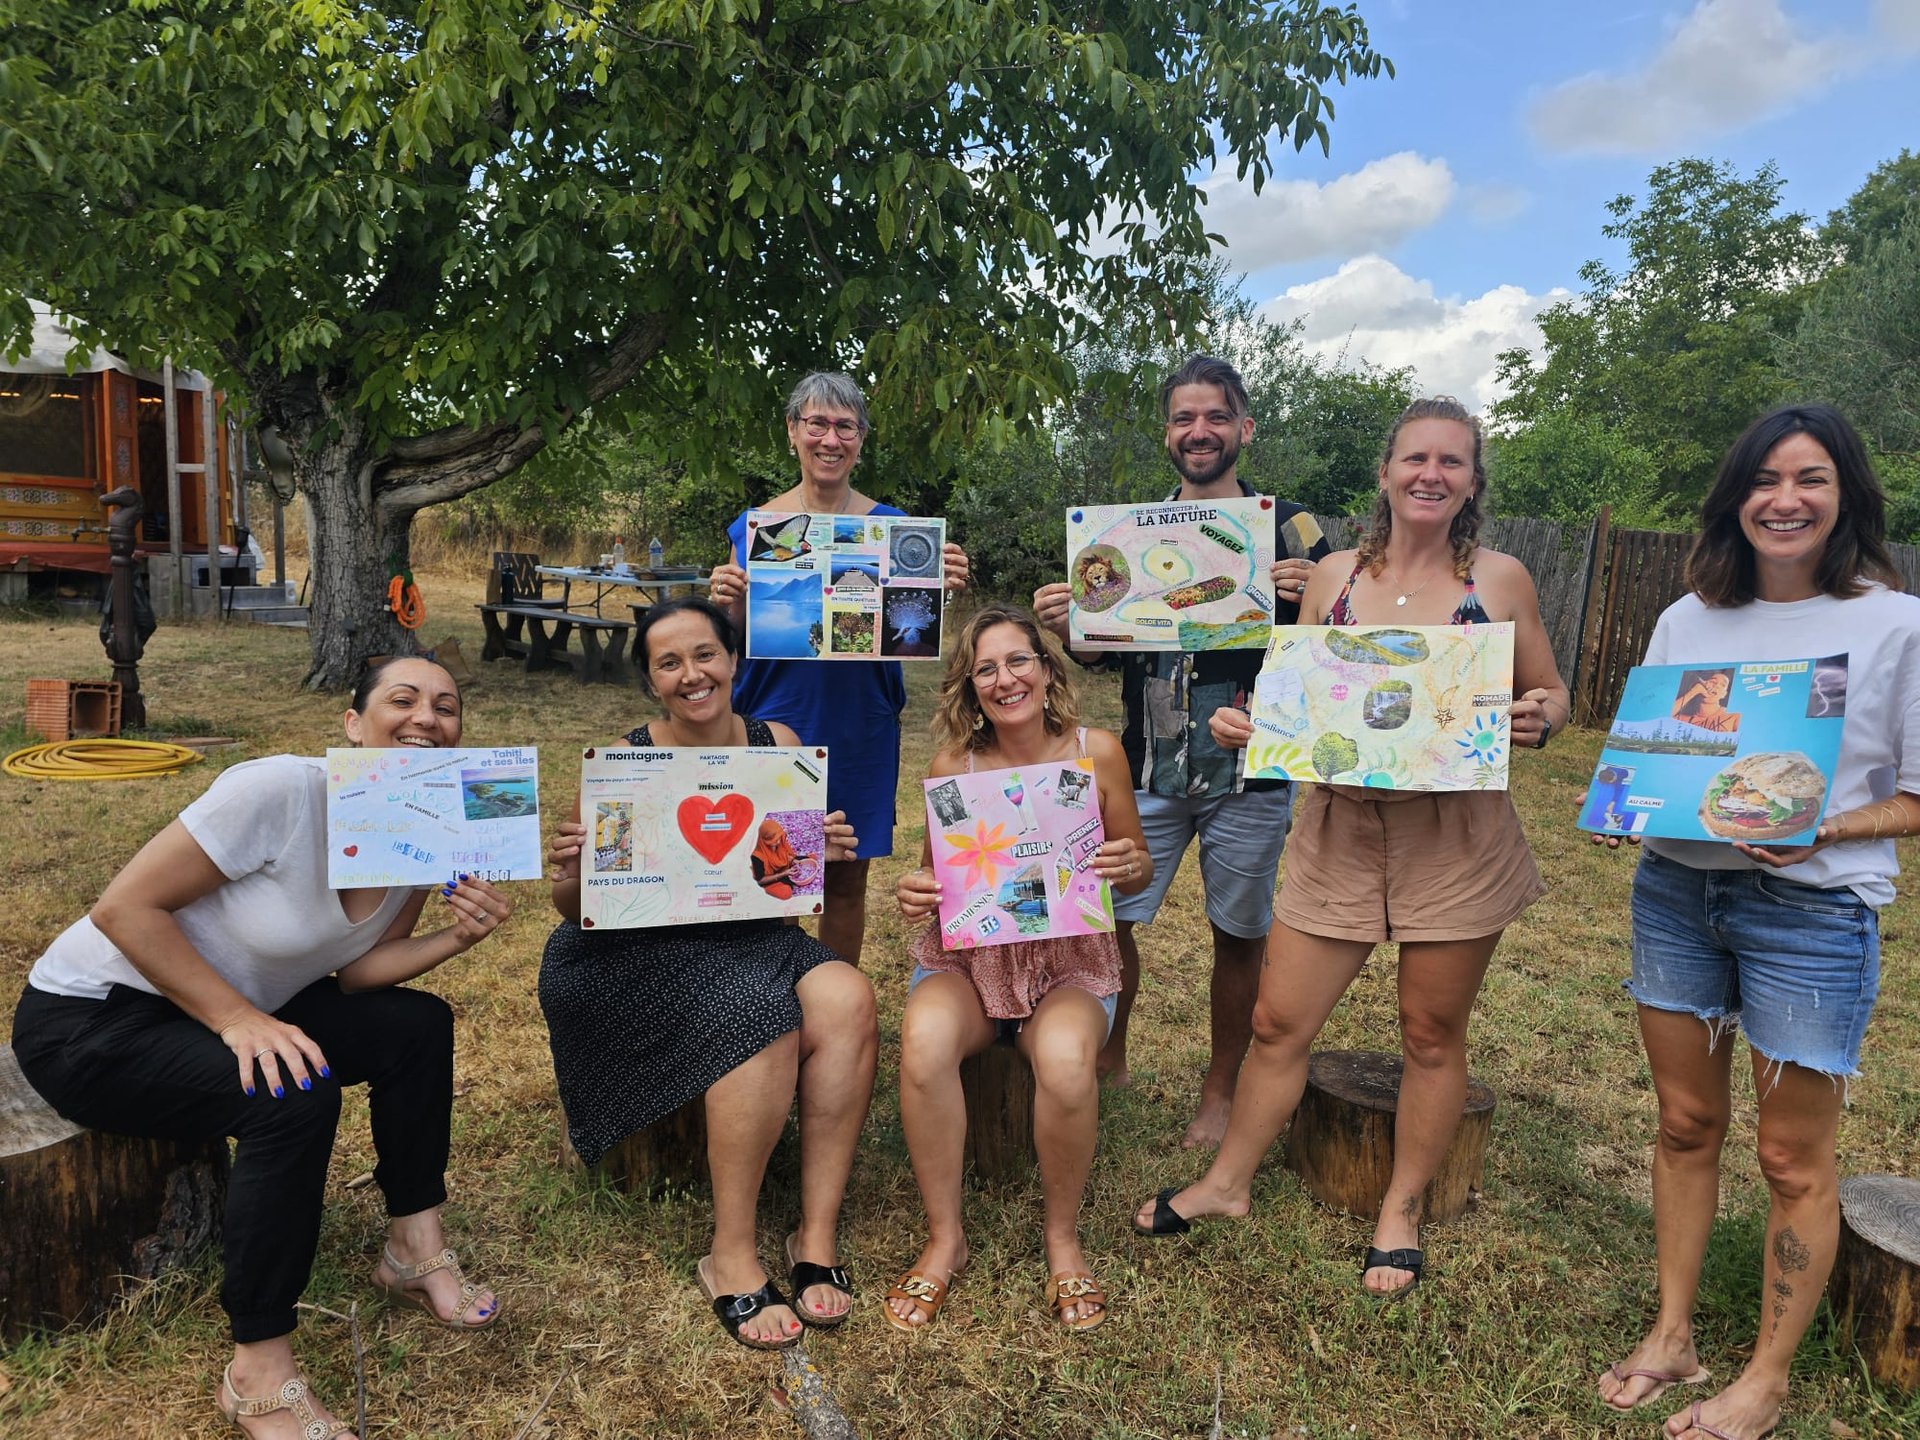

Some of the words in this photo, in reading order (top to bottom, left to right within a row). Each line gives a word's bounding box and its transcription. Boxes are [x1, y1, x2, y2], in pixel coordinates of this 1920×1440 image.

[1146, 505, 1193, 514] RECONNECTER
[1137, 516, 1155, 526] LA
[1159, 509, 1217, 525] NATURE
[1200, 524, 1245, 554] VOYAGEZ
[1744, 665, 1758, 673] LA
[1761, 663, 1807, 673] FAMILLE
[1473, 694, 1510, 702] NOMADE
[1254, 717, 1296, 739] Confiance
[492, 748, 522, 758] Tahiti
[605, 751, 674, 762] montagnes
[698, 782, 734, 790] mission
[404, 802, 413, 810] EN
[413, 806, 440, 819] FAMILLE
[1066, 818, 1100, 844] PRENEZ
[1011, 841, 1053, 858] PLAISIRS
[1081, 839, 1096, 851] LE
[587, 878, 609, 886] PAYS
[612, 877, 624, 885] DU
[626, 876, 665, 884] DRAGON
[946, 891, 994, 934] PROMESSES
